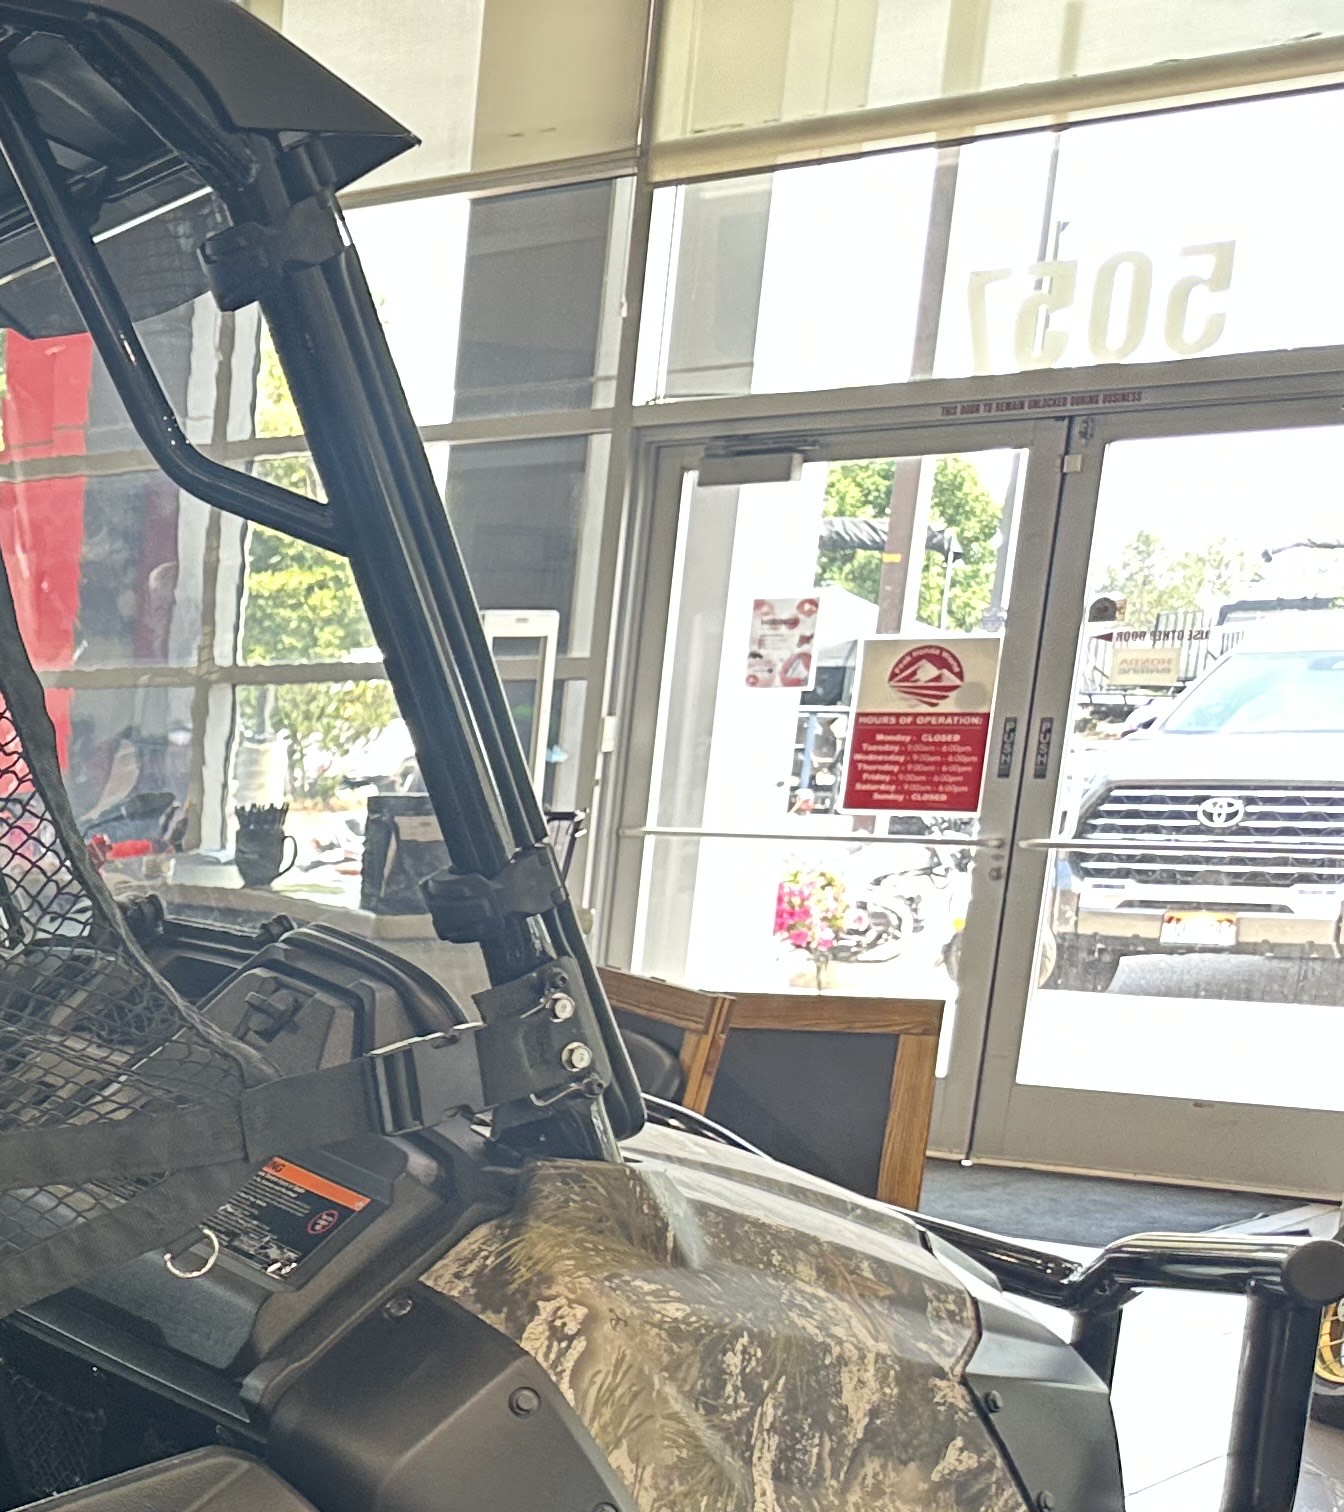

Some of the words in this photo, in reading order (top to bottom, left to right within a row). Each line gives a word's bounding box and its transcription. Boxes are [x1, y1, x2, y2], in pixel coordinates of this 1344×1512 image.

[941, 404, 957, 416] THIS
[960, 403, 979, 414] DOOR
[995, 400, 1025, 412] REMAIN
[1028, 396, 1067, 410] UNLOCKED
[1070, 394, 1099, 406] DURING
[1103, 391, 1142, 405] BUSINESS
[859, 715, 896, 725] HOURS
[899, 715, 913, 725] OF
[916, 715, 982, 725] OPERATION:
[921, 733, 961, 743] CLOSED
[1000, 721, 1015, 765] PUSH
[1037, 721, 1051, 766] PUSH
[911, 793, 947, 802] CLOSED
